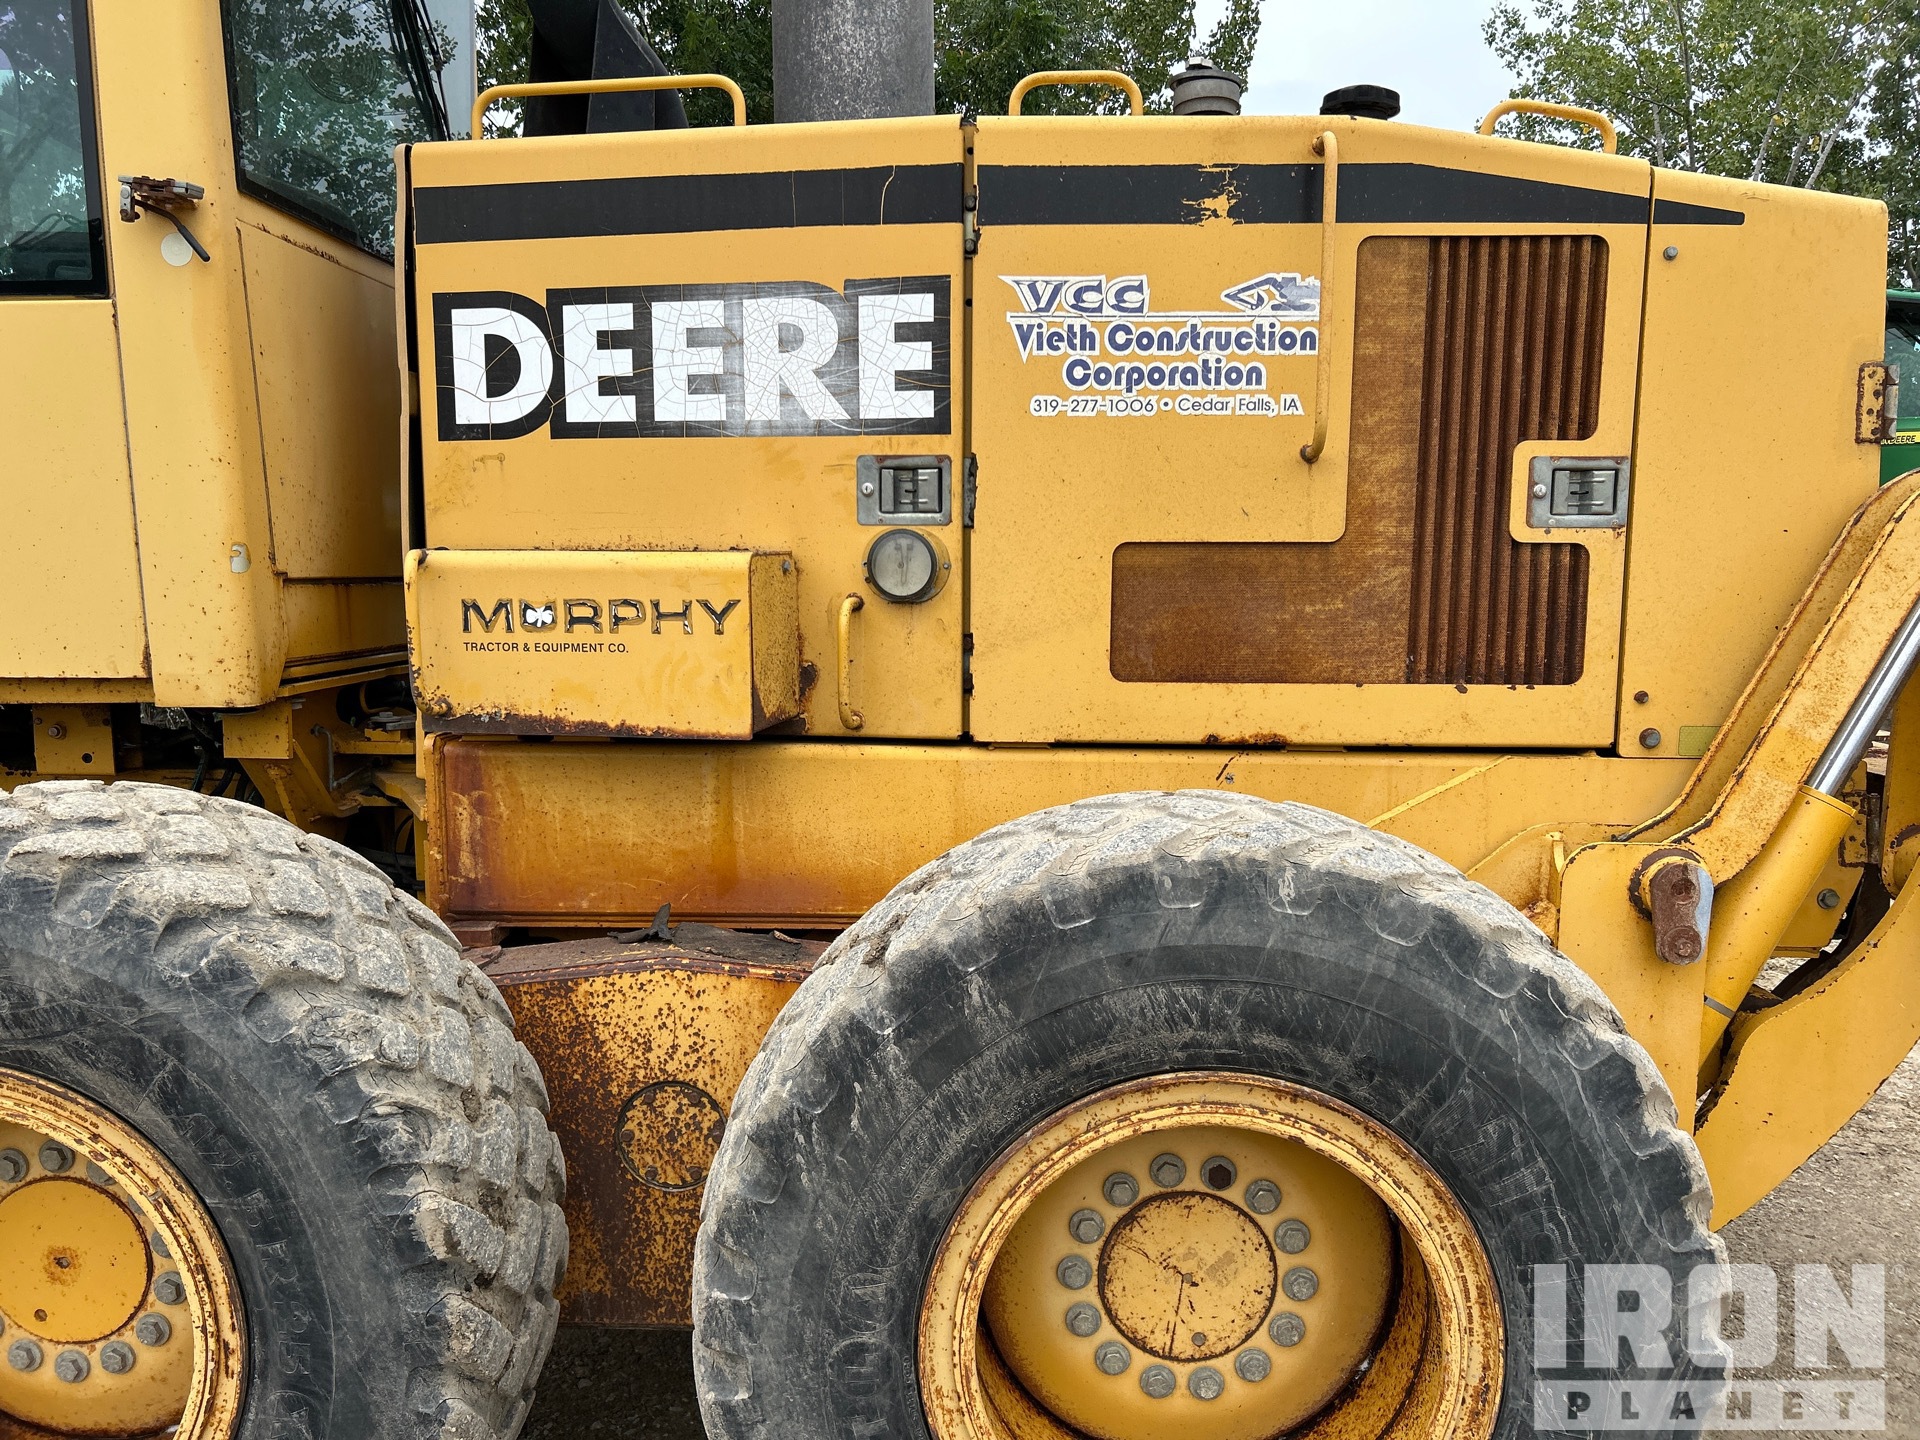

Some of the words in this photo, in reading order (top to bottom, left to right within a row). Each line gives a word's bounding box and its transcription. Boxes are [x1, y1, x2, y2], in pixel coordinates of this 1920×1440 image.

[1010, 279, 1147, 315] VCC
[1014, 322, 1096, 352] Vieth
[1107, 322, 1317, 352] Construction
[451, 292, 935, 425] DEERE
[1065, 358, 1263, 394] Corporation
[1033, 398, 1154, 413] 319-277-1006
[1178, 397, 1230, 413] Cedar
[1238, 397, 1275, 414] Falls,
[1283, 398, 1299, 412] IA
[461, 598, 742, 635] MURPHY
[463, 642, 519, 653] TRACTOR
[522, 642, 530, 653] &
[534, 642, 605, 654] EQUIPMENT
[608, 643, 629, 654] CO.
